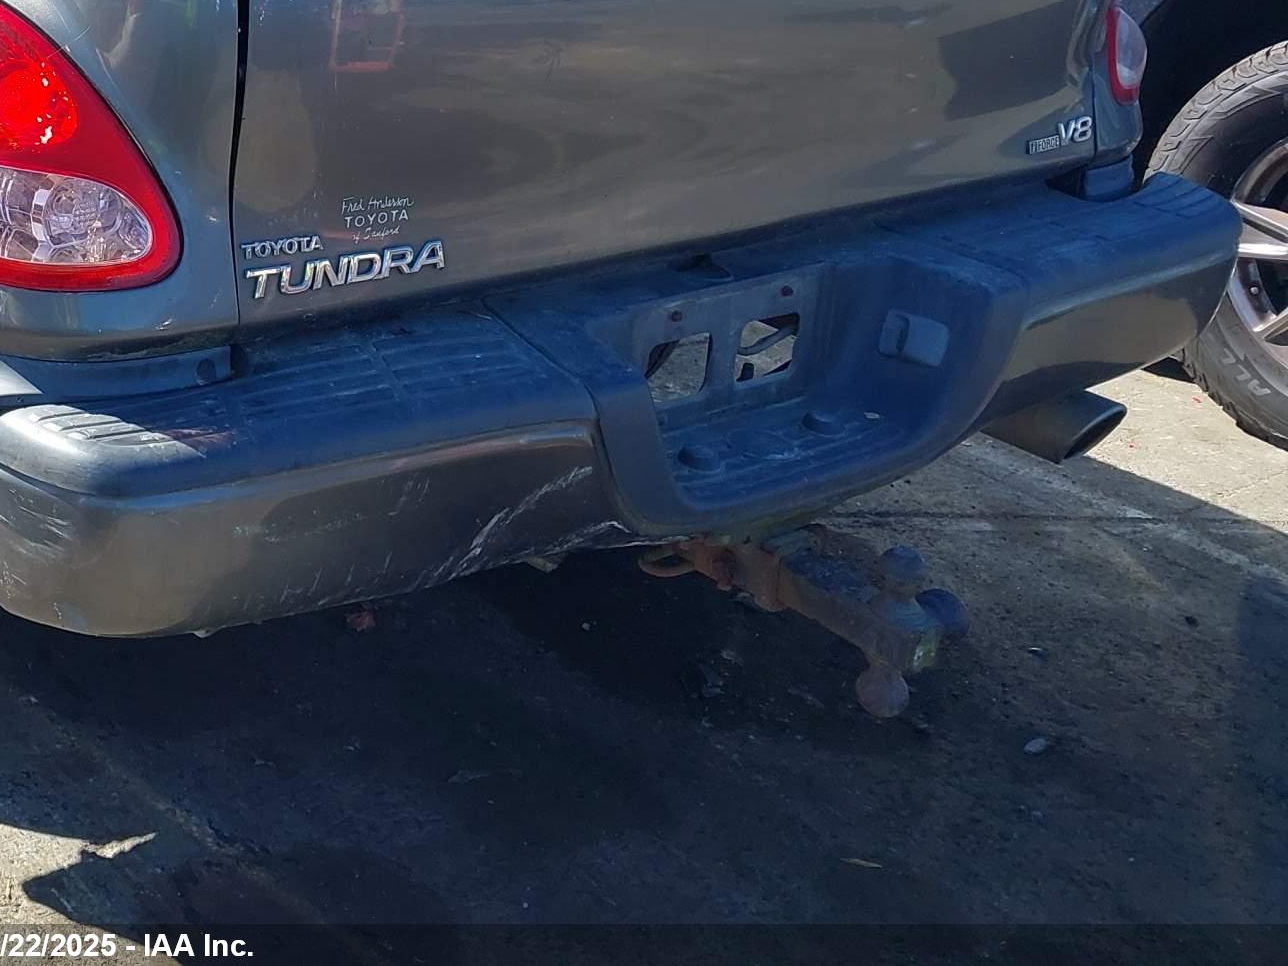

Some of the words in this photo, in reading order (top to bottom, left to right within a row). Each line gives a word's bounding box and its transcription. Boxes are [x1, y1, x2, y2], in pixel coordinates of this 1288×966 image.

[1058, 116, 1093, 145] V8
[344, 209, 409, 229] TOYOTA
[241, 235, 324, 260] TOYOTA
[245, 240, 445, 299] TUNDRA
